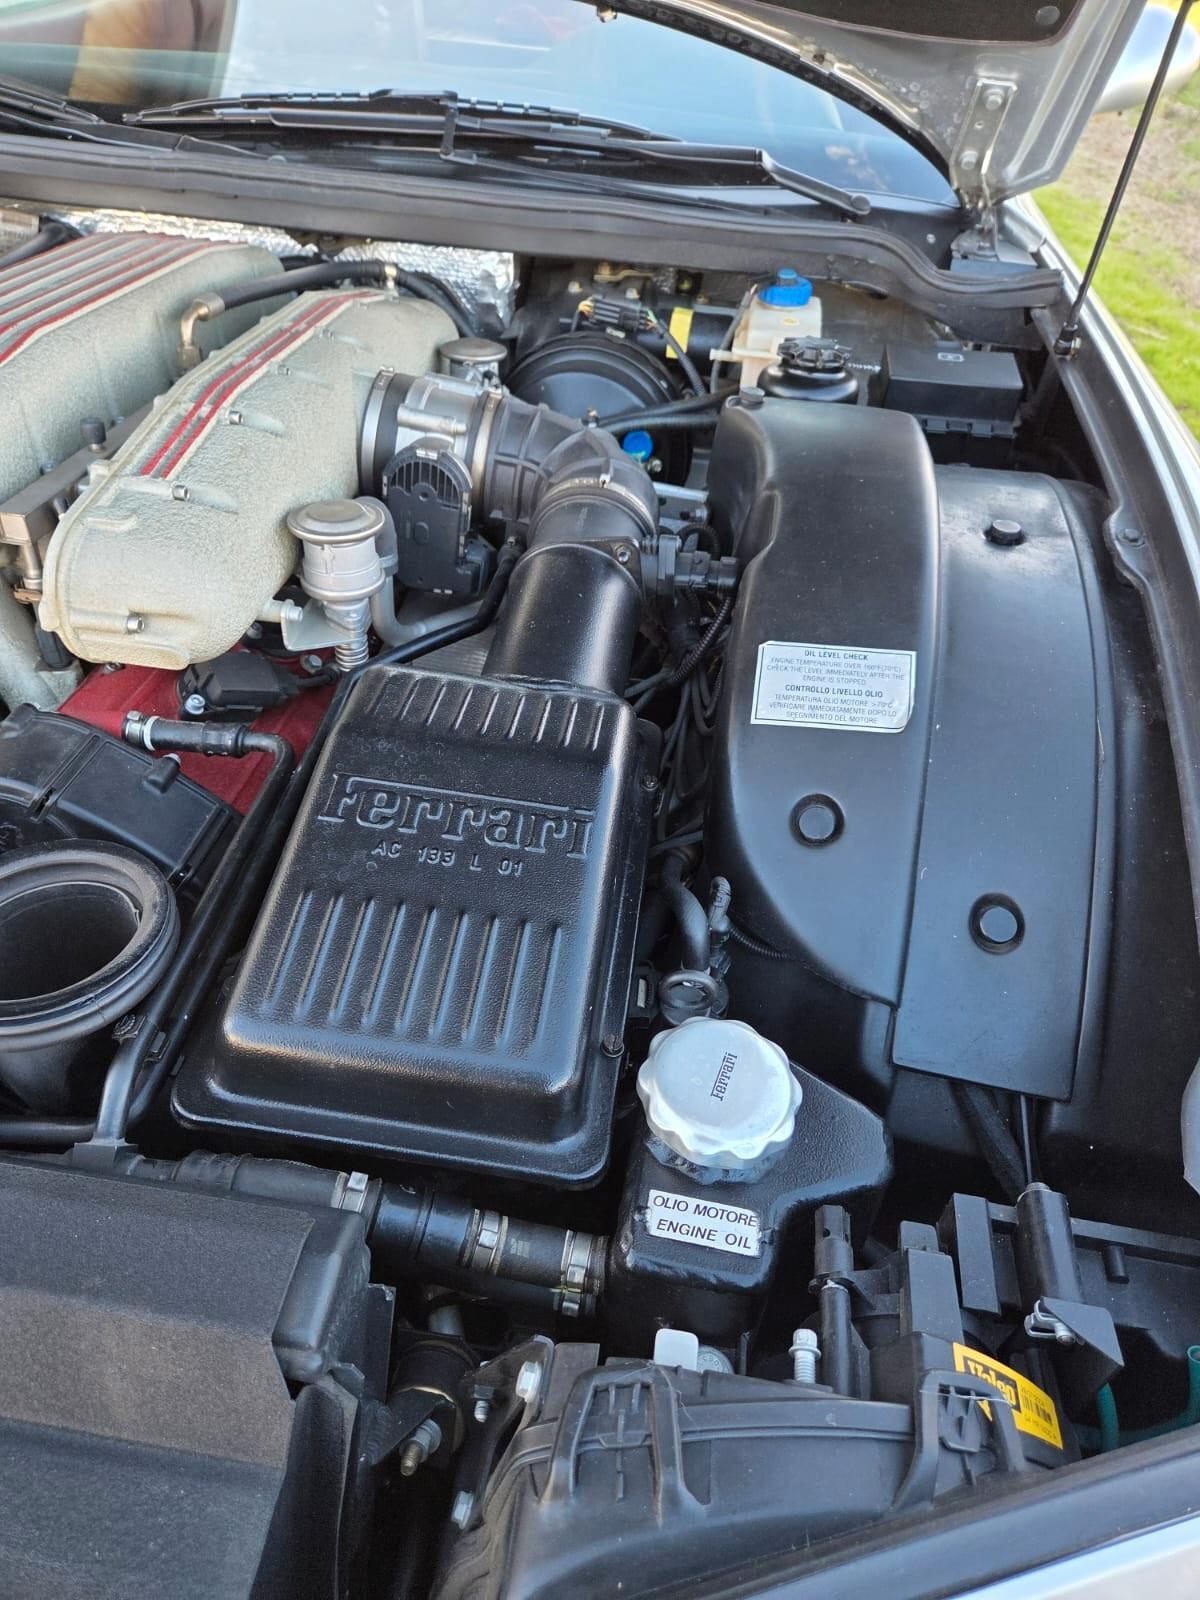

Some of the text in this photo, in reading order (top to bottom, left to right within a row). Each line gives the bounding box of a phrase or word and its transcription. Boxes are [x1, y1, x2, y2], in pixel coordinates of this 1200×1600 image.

[818, 651, 841, 659] LEVEL
[796, 659, 843, 668] TEMPERATURE
[804, 667, 823, 675] LEVEL
[825, 669, 868, 678] IMMEDIATELY
[785, 684, 883, 698] CONTROLLO LIVELLO OLIO
[775, 694, 822, 703] TEMPERATURA
[840, 699, 868, 707] MOTORE
[769, 702, 806, 710] VERIFICARE
[808, 705, 866, 715] IMMEDIATAMENTE
[785, 711, 833, 720] SPEGNIMENTO
[849, 716, 878, 724] MOTORE
[317, 772, 595, 859] Ferrari
[371, 841, 523, 877] AC 133 L 01
[710, 1051, 738, 1101] Ferrari
[652, 1195, 758, 1228] OLIO MOTORE
[656, 1219, 752, 1250] ENGINE OIL
